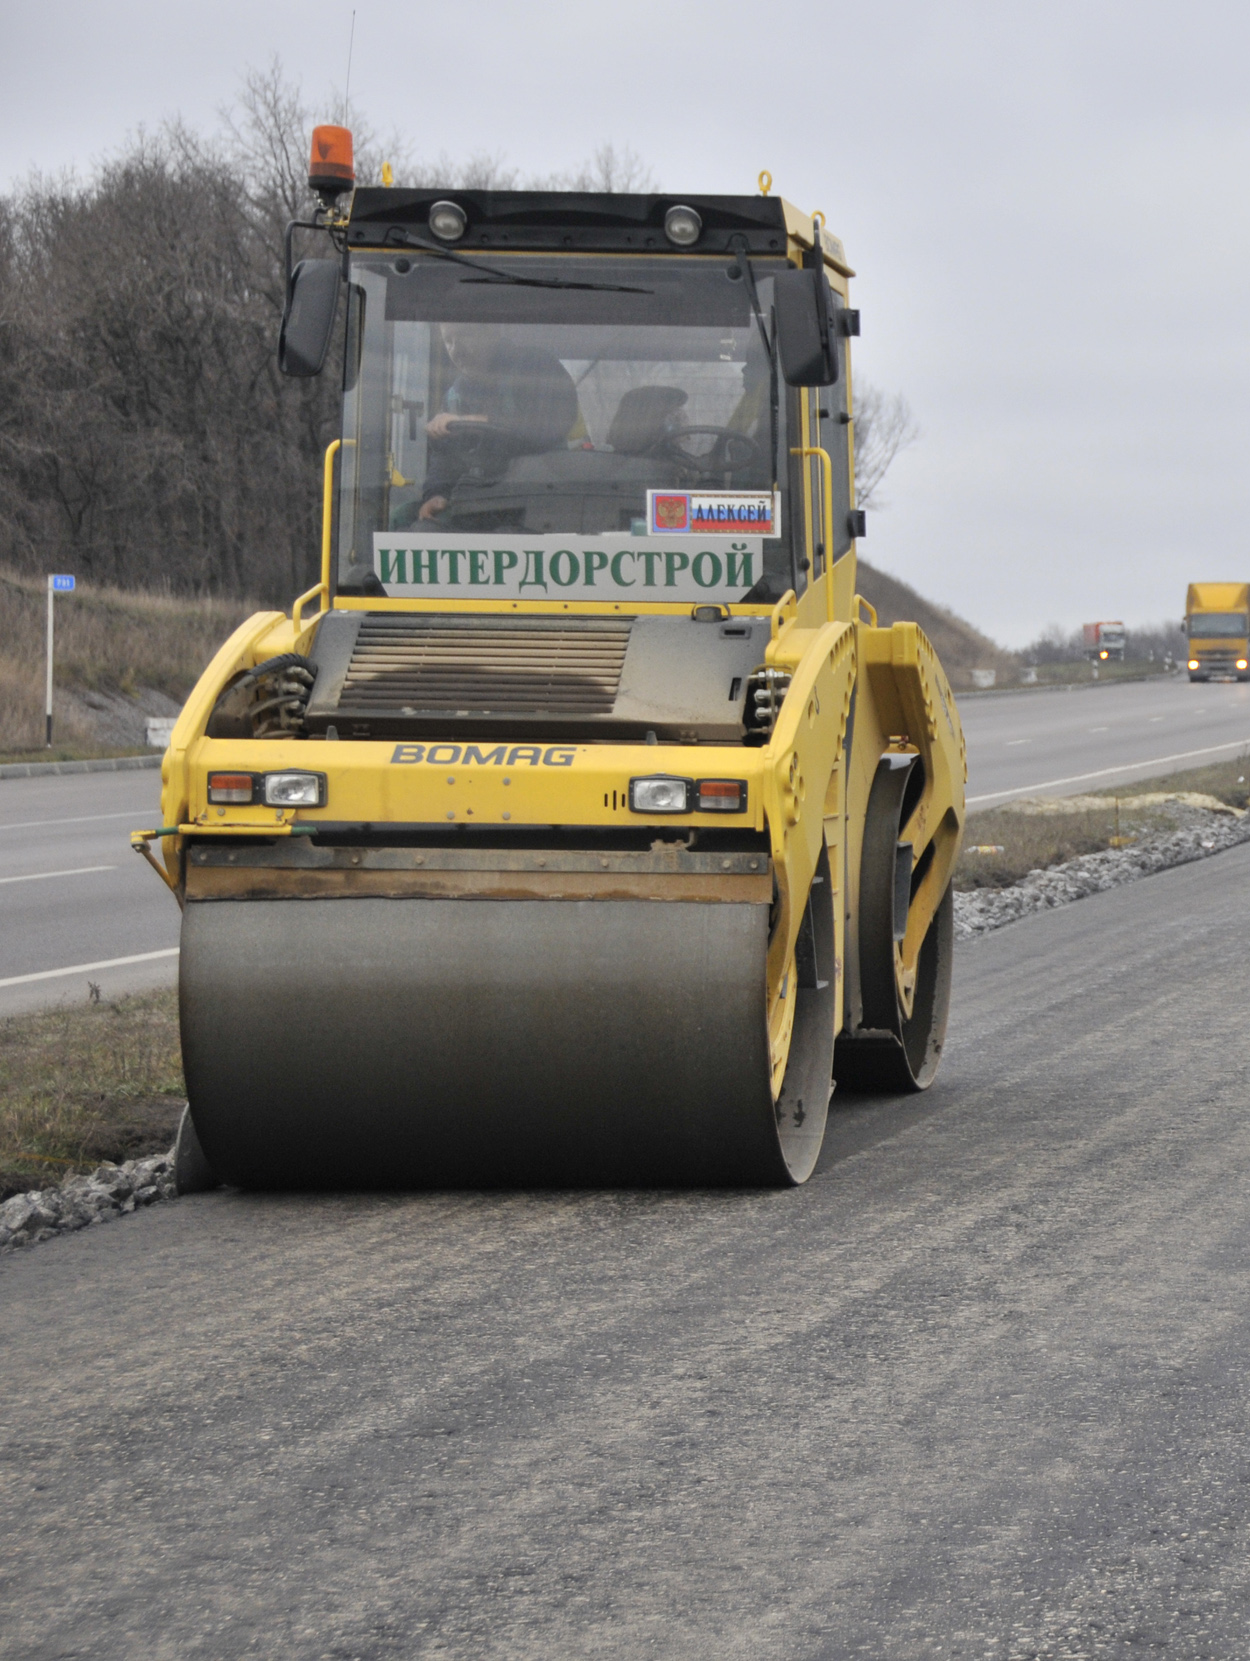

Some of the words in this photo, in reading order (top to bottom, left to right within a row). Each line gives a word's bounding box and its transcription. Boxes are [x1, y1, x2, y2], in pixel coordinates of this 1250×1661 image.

[696, 500, 767, 523] АЛЕКСЕЙ
[378, 542, 754, 594] ИНТЕРДОРСТРОЙ
[390, 744, 577, 766] BOMAG
